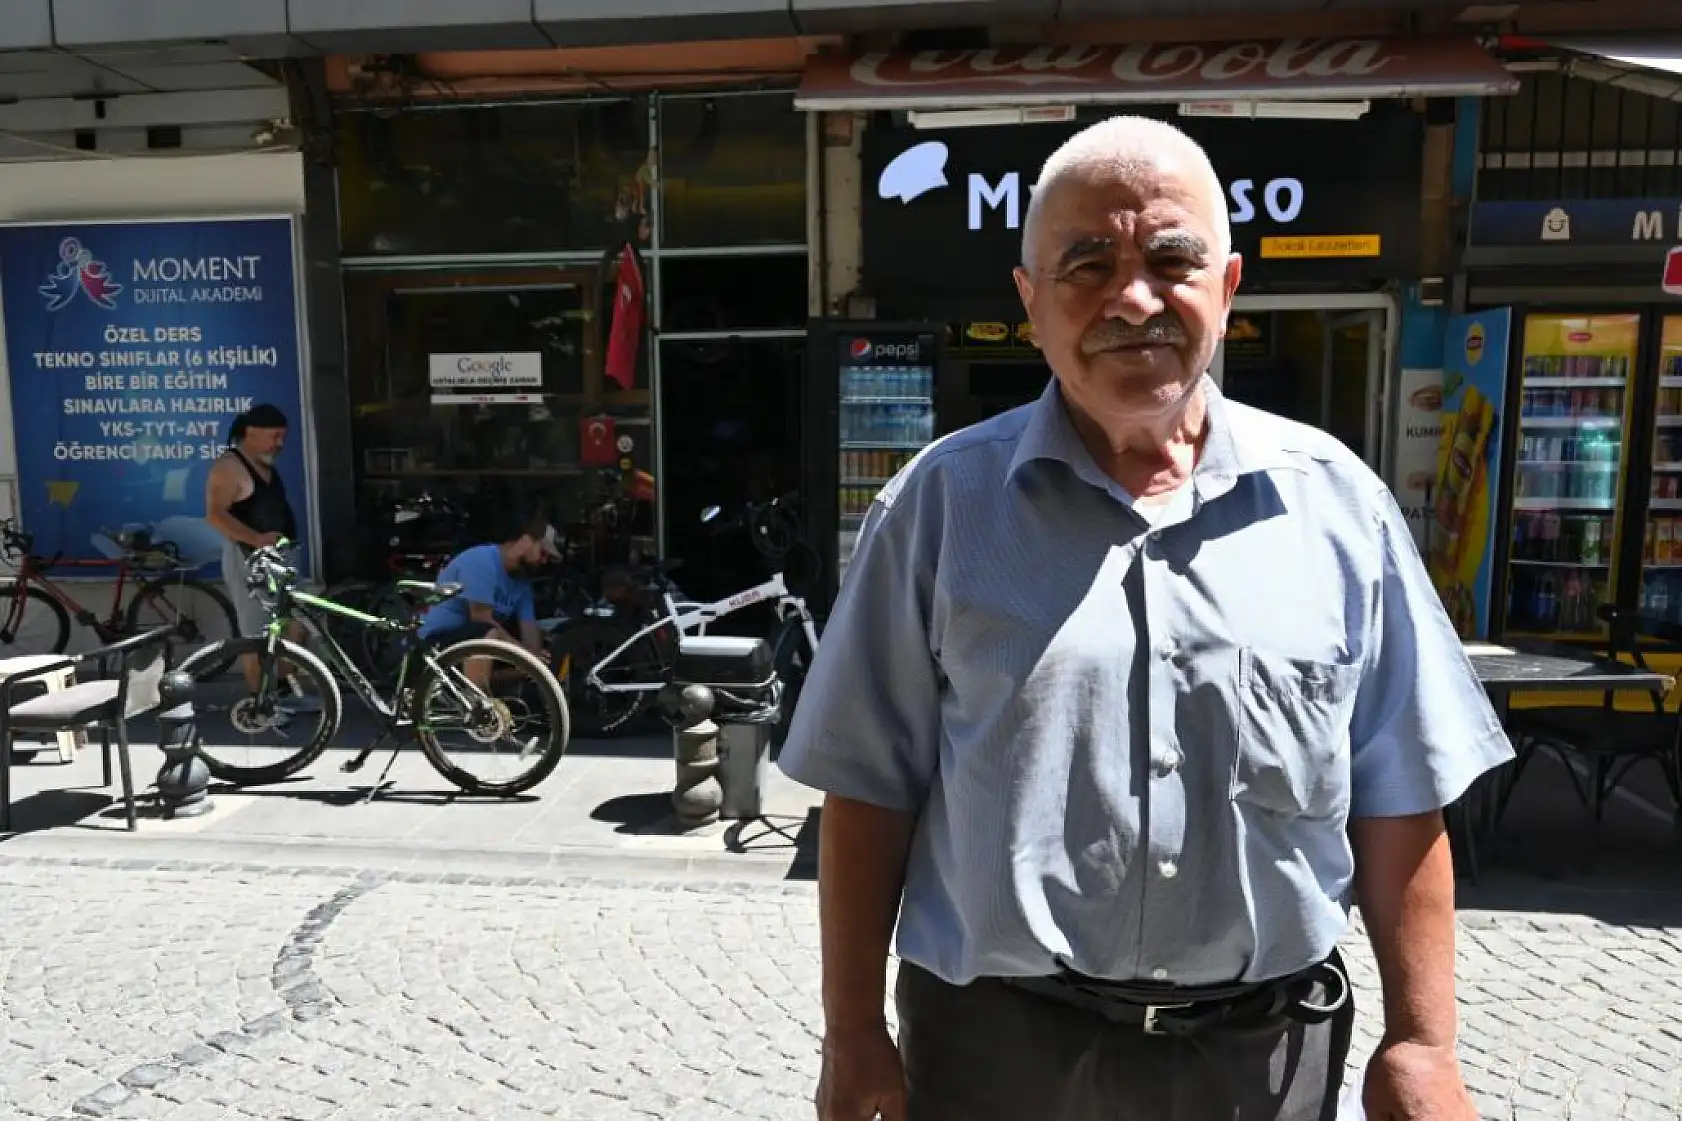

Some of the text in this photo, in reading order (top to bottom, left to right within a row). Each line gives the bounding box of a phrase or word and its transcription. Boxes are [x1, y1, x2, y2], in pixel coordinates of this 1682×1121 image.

[133, 255, 262, 282] MOMENT
[104, 324, 202, 343] ÖZEL DERS
[33, 344, 277, 370] TEKNO SINIFLAR (6 KİŞİLİK)
[875, 340, 919, 360] pepsi
[456, 356, 513, 378] Google
[84, 370, 228, 390] BİRE BİR EĞİTİM
[63, 397, 252, 414] SINAVLARA HAZIRLIK
[100, 420, 220, 437] YKS-TYT-AYT
[53, 441, 138, 460] ÖĞRENCİ
[145, 440, 194, 460] TAKİP
